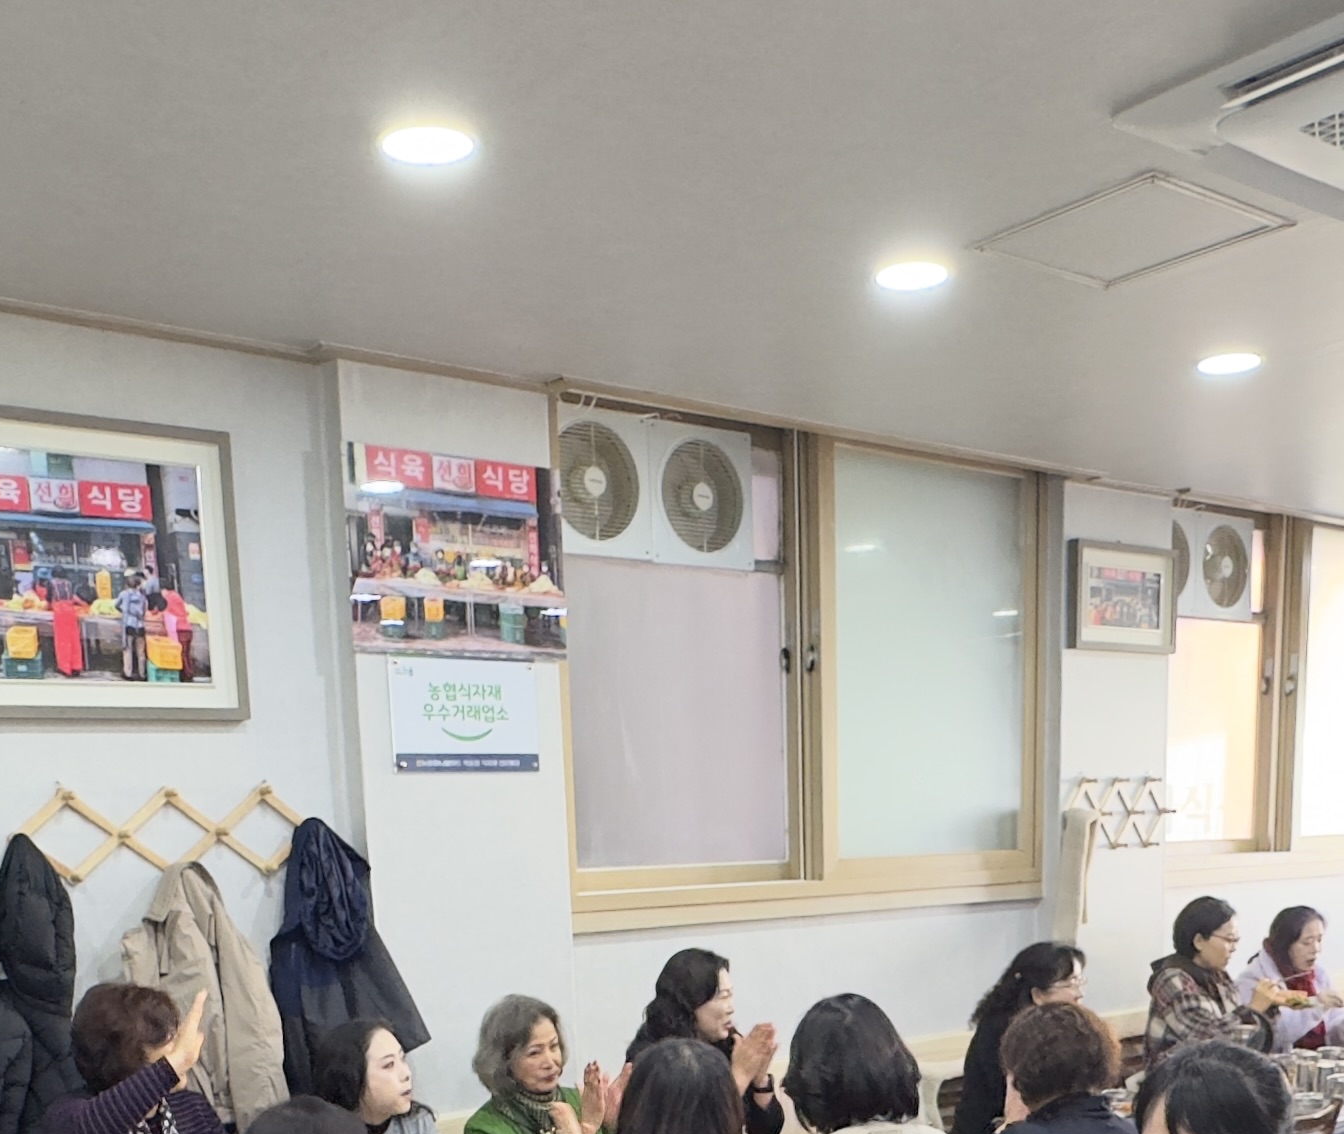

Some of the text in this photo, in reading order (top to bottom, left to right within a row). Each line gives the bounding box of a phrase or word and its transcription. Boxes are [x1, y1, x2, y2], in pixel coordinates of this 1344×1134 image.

[373, 450, 424, 480] 식육
[482, 466, 530, 495] 식당
[87, 485, 144, 513] 식당
[428, 682, 502, 701] 농협식자재
[422, 703, 509, 723] 우수거래업소
